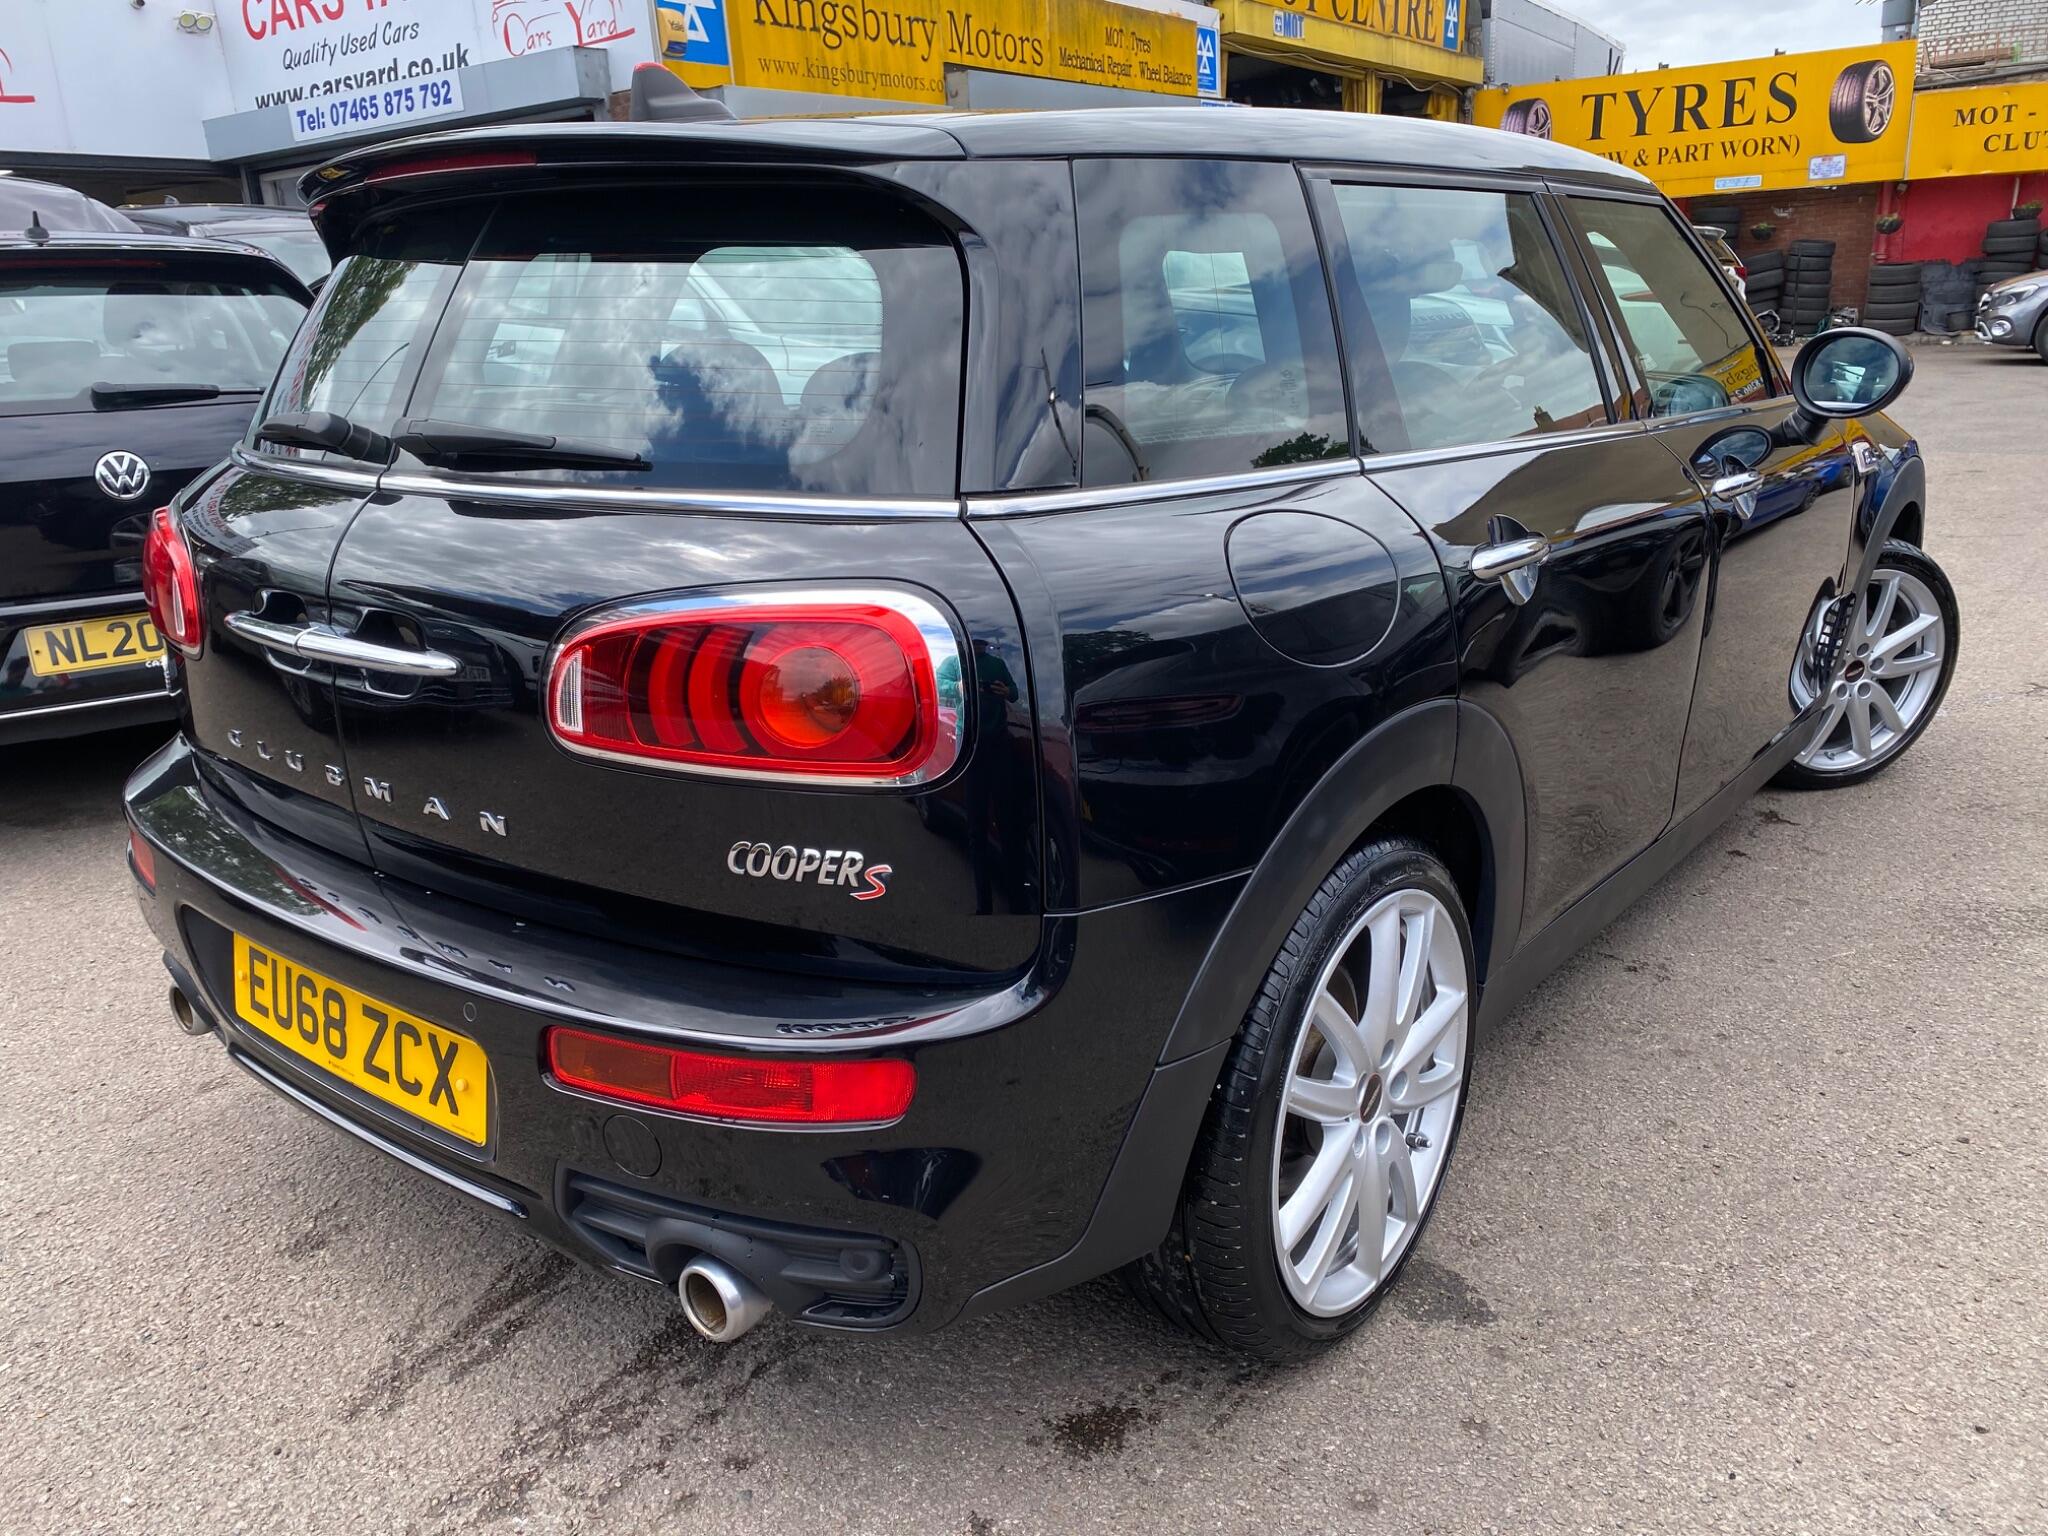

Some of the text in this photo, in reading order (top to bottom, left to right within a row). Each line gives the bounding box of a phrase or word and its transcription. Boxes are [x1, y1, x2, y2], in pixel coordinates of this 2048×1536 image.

[283, 21, 420, 70] Quality Used Cars
[504, 1, 624, 57] Cars Yard
[753, 0, 1044, 67] Kingsbury Motors
[1105, 26, 1151, 56] MOT Tyres
[1283, 12, 1304, 38] MOT
[1059, 46, 1104, 74] Mechanical
[1107, 55, 1133, 81] Repair
[1139, 61, 1162, 83] Wheel
[1163, 66, 1193, 87] Balance
[297, 79, 452, 132] Tel: 07465 875 792
[1581, 71, 1799, 141] TYRES
[1953, 104, 2018, 127] MOT
[1633, 148, 1649, 168] &
[1656, 142, 1714, 165] PART
[1719, 134, 1801, 159] WORN)
[43, 617, 164, 666] NL20
[227, 727, 508, 837] CLUBMAN
[727, 841, 864, 888] COOPER
[248, 945, 459, 1116] EU68 ZCX
